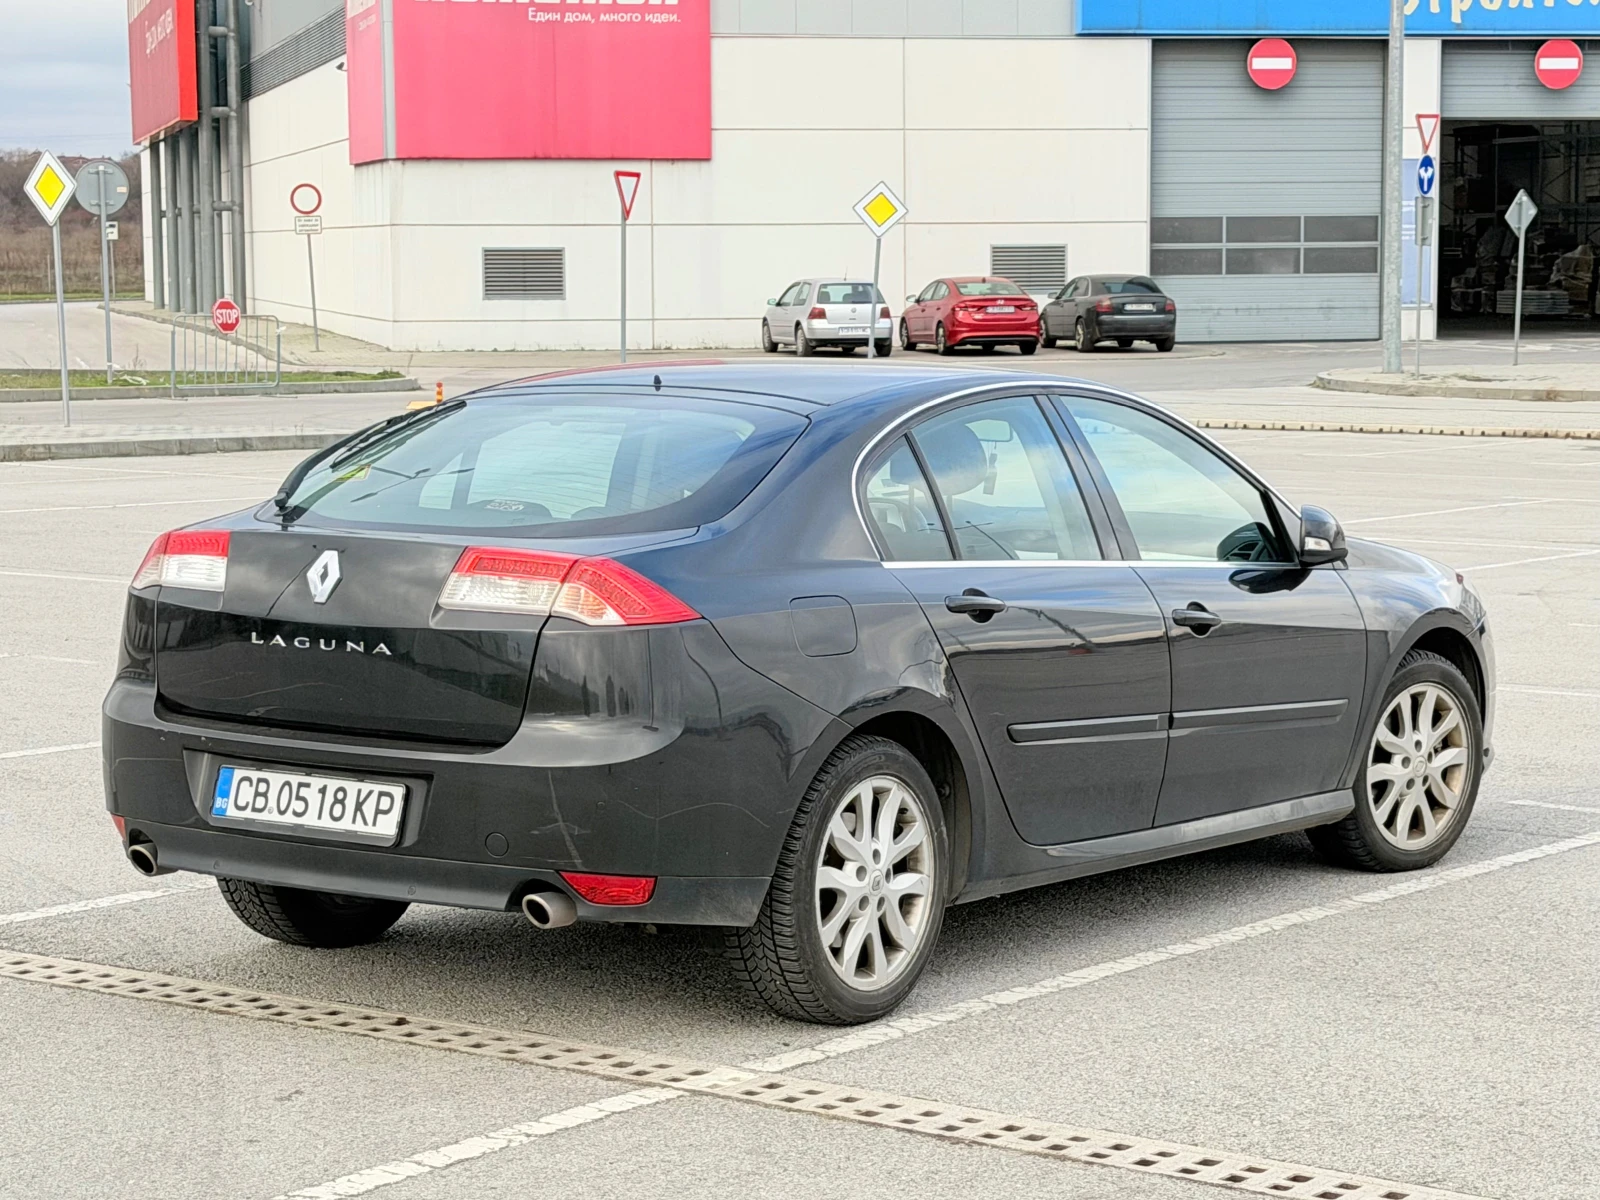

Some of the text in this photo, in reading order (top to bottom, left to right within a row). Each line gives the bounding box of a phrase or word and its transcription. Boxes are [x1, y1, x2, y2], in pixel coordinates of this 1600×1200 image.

[528, 7, 682, 24] Един дом, много идеи.
[216, 308, 239, 324] STOP
[251, 631, 393, 656] LAGUNA
[215, 796, 229, 809] BG
